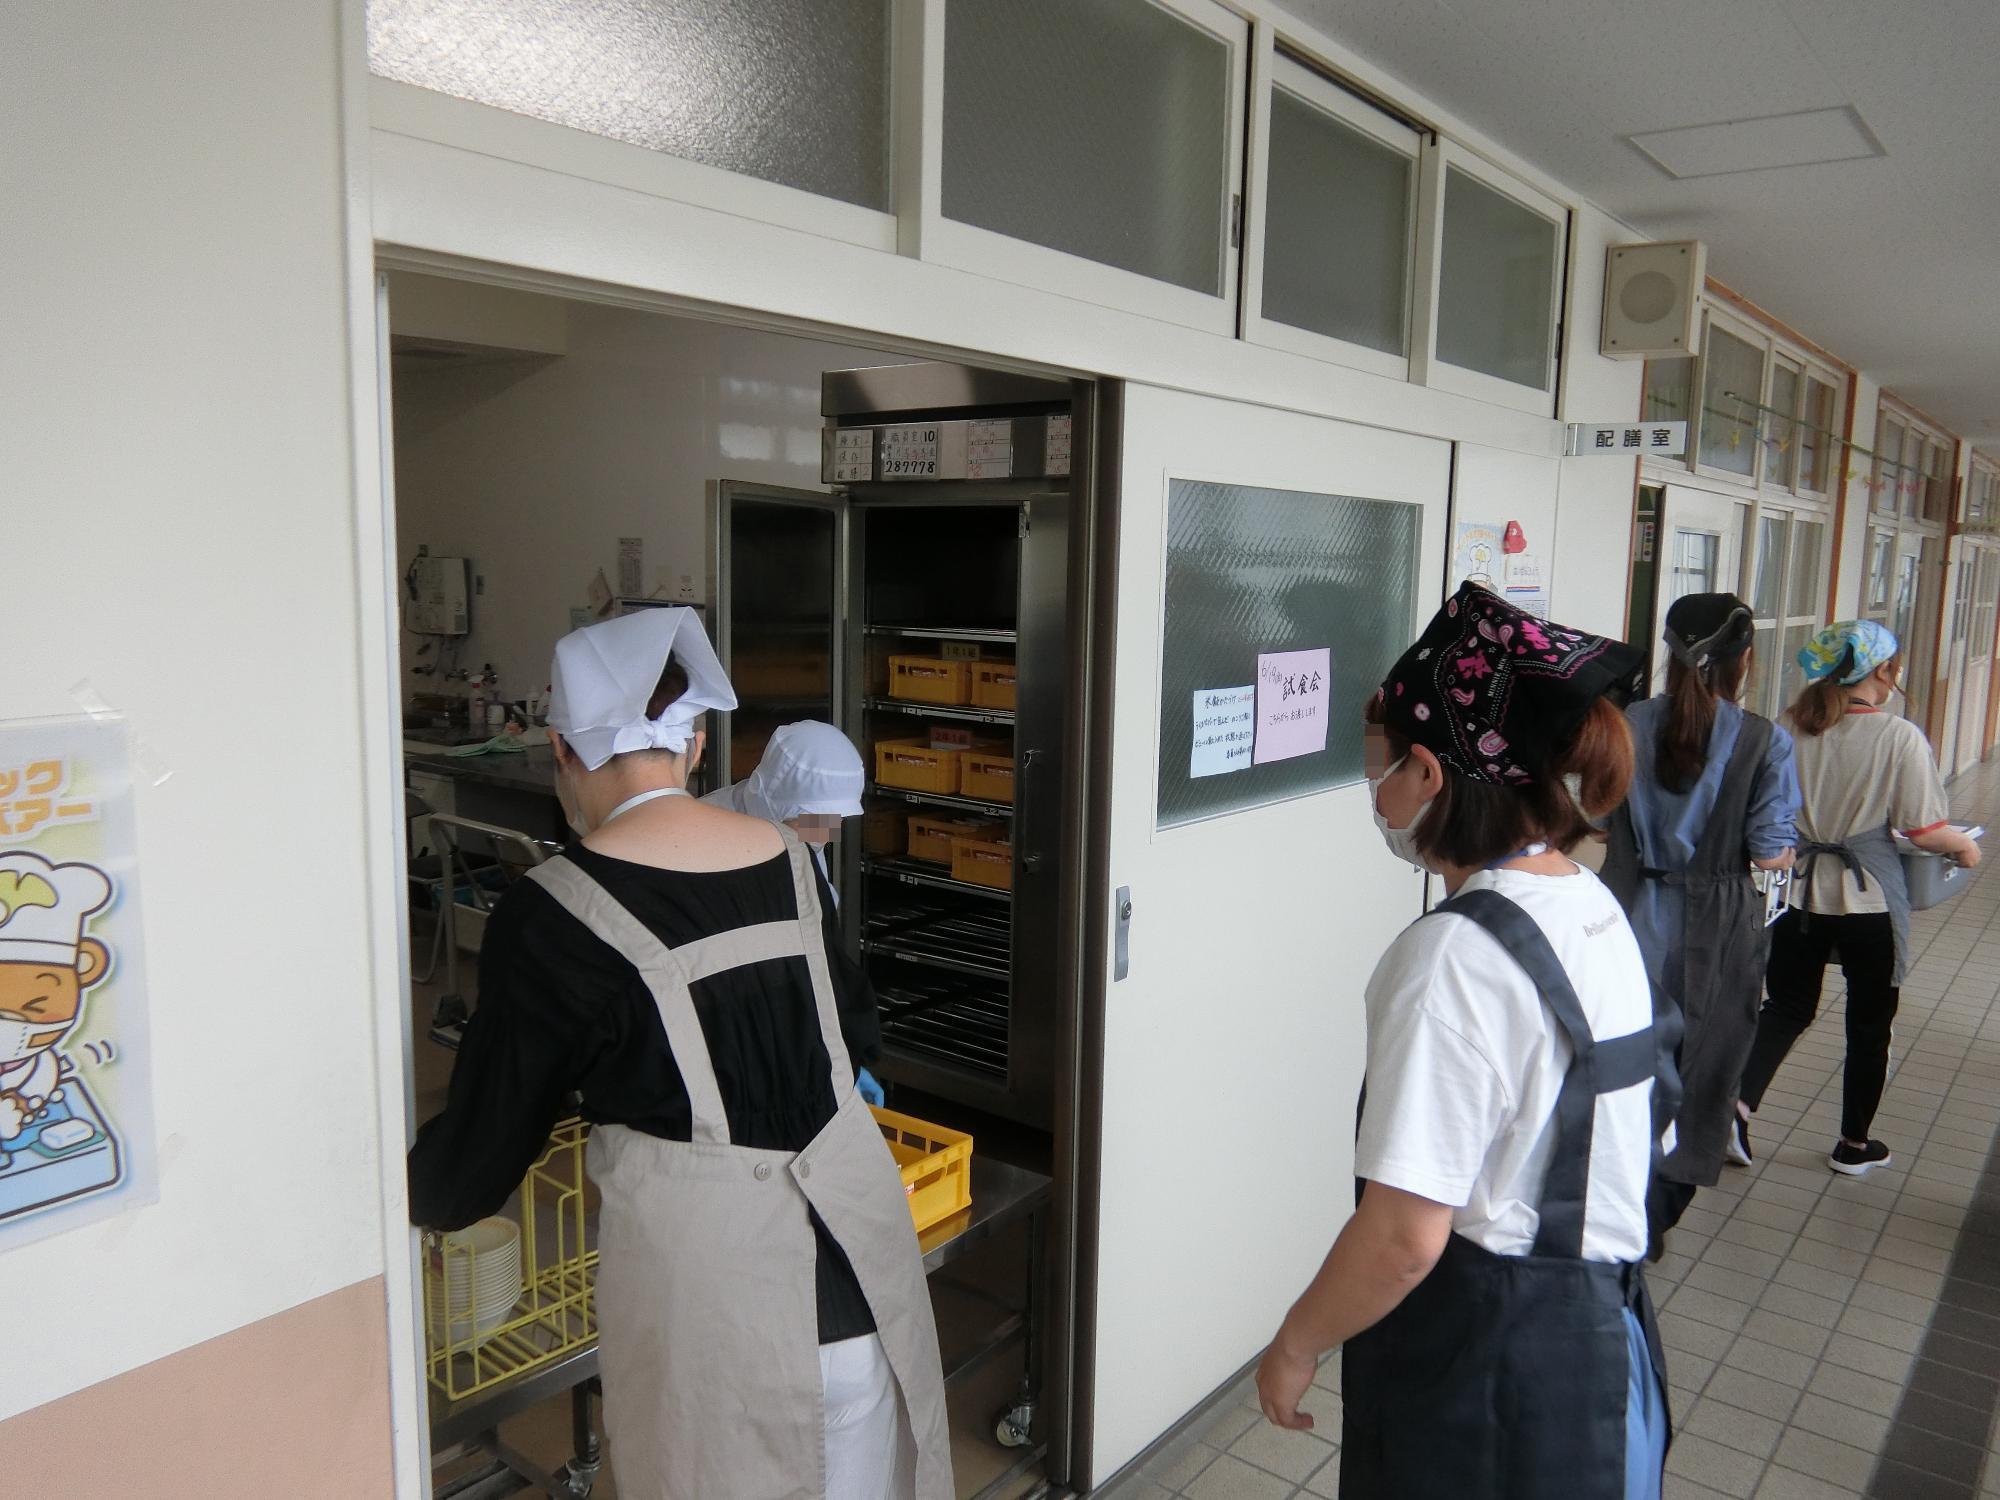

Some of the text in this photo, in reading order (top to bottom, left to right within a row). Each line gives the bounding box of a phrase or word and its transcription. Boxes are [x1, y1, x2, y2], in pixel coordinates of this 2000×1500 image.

[1595, 429, 1671, 448] 配膳室
[1282, 670, 1322, 701] 試食会
